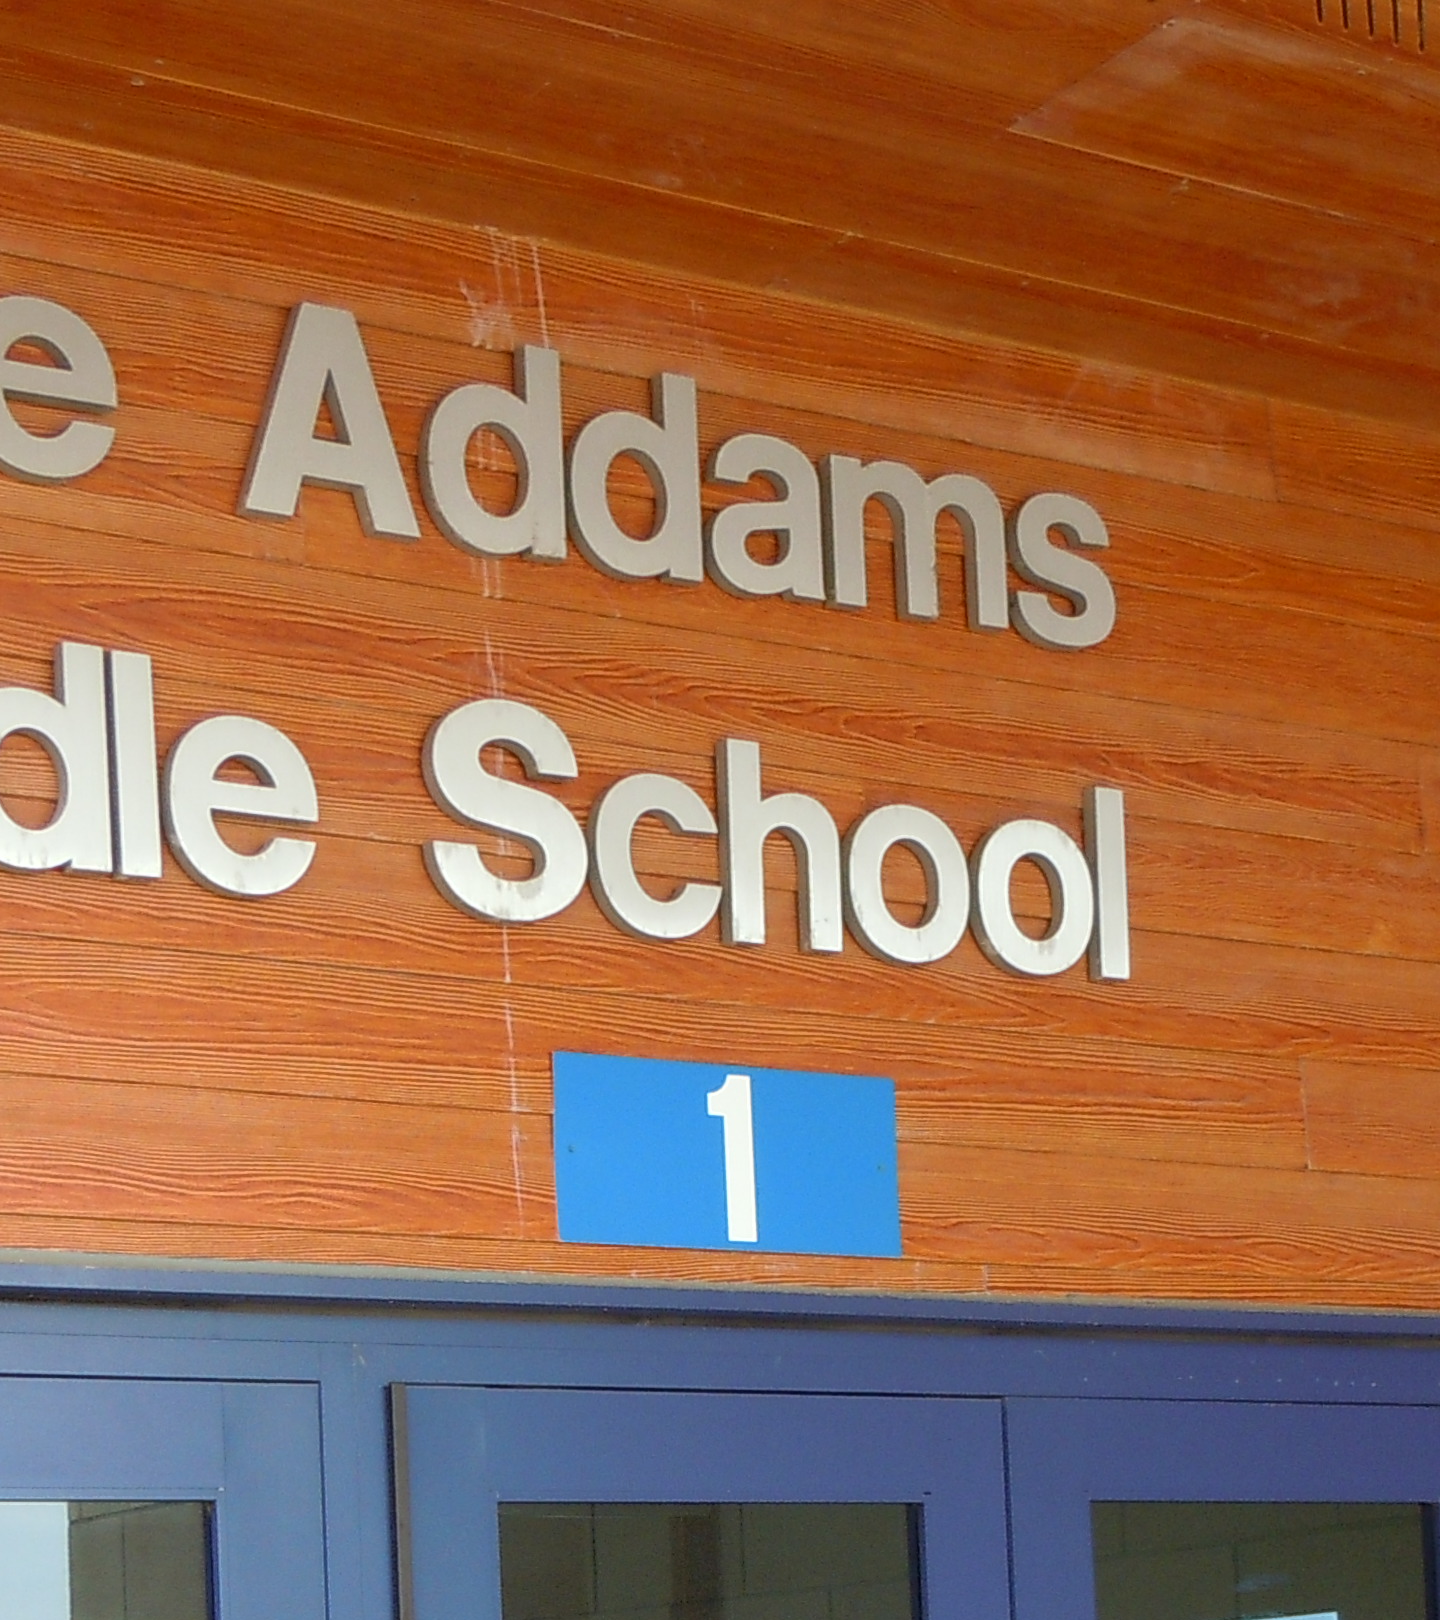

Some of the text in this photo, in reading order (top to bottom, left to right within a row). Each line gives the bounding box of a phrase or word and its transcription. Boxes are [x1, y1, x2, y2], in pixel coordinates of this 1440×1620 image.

[236, 300, 1117, 651] Addams
[421, 697, 1130, 981] School
[706, 1073, 758, 1243] 1
